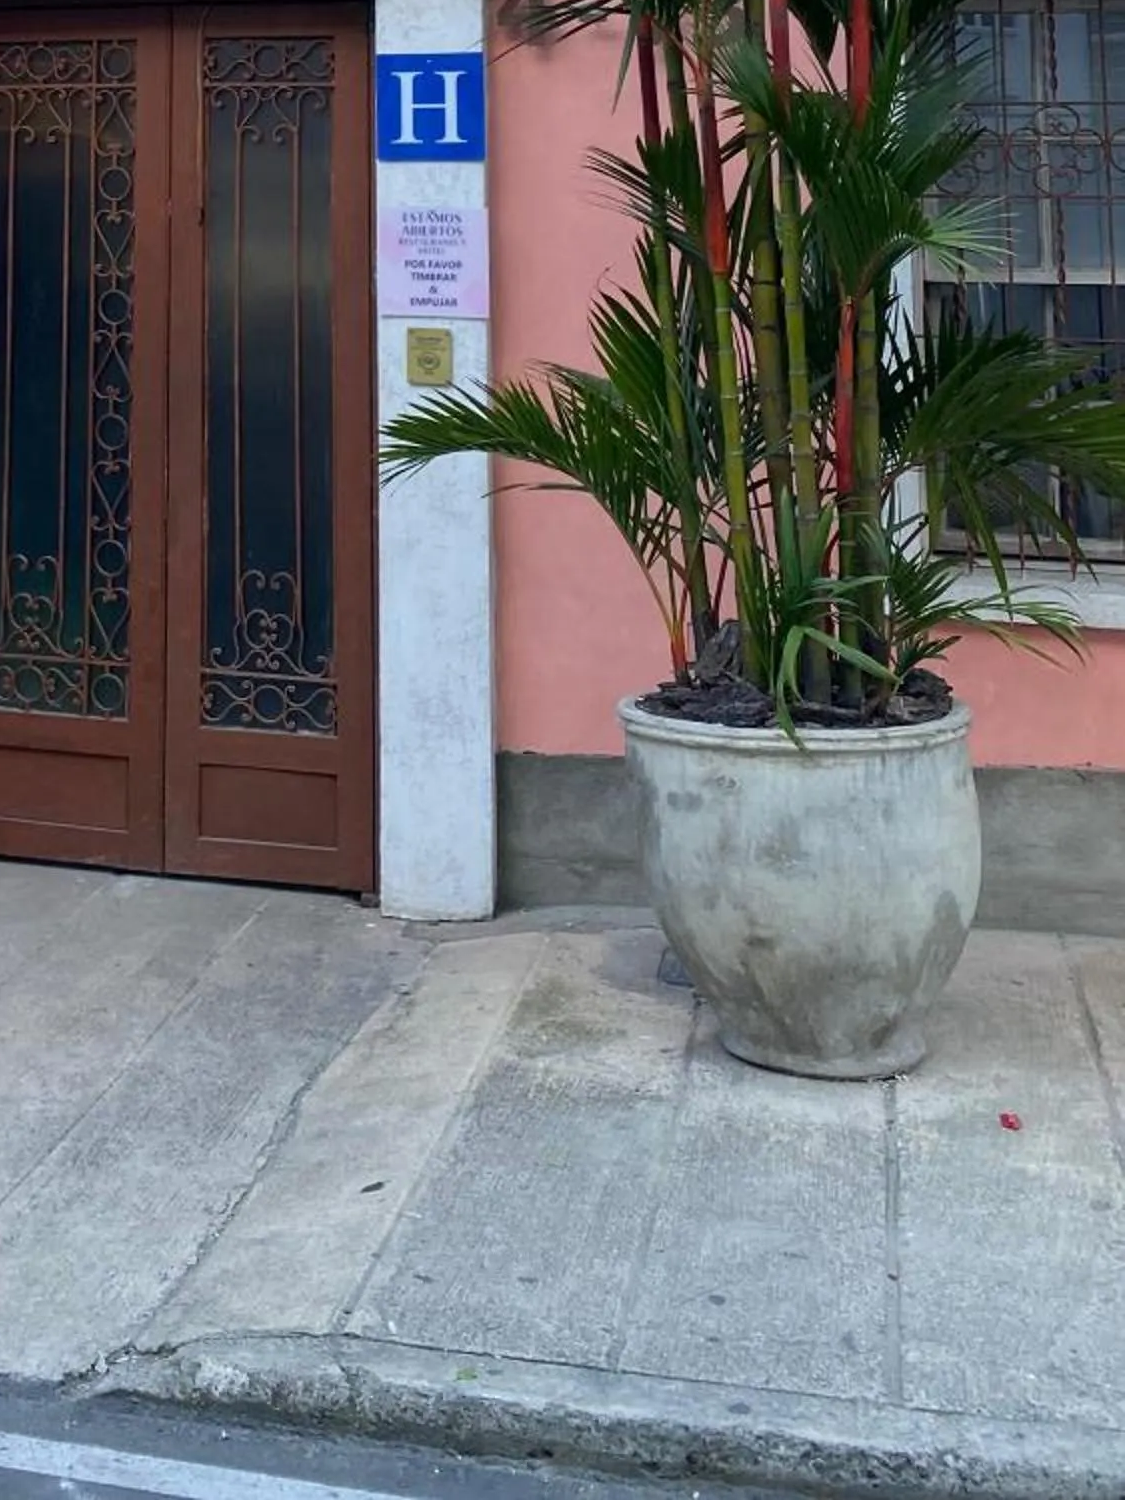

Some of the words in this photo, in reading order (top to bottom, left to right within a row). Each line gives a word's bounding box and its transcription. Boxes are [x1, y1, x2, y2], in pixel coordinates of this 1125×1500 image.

[390, 70, 468, 144] H
[404, 259, 426, 269] POR
[428, 259, 463, 269] FAVOR
[410, 297, 458, 307] EMPUJAR
